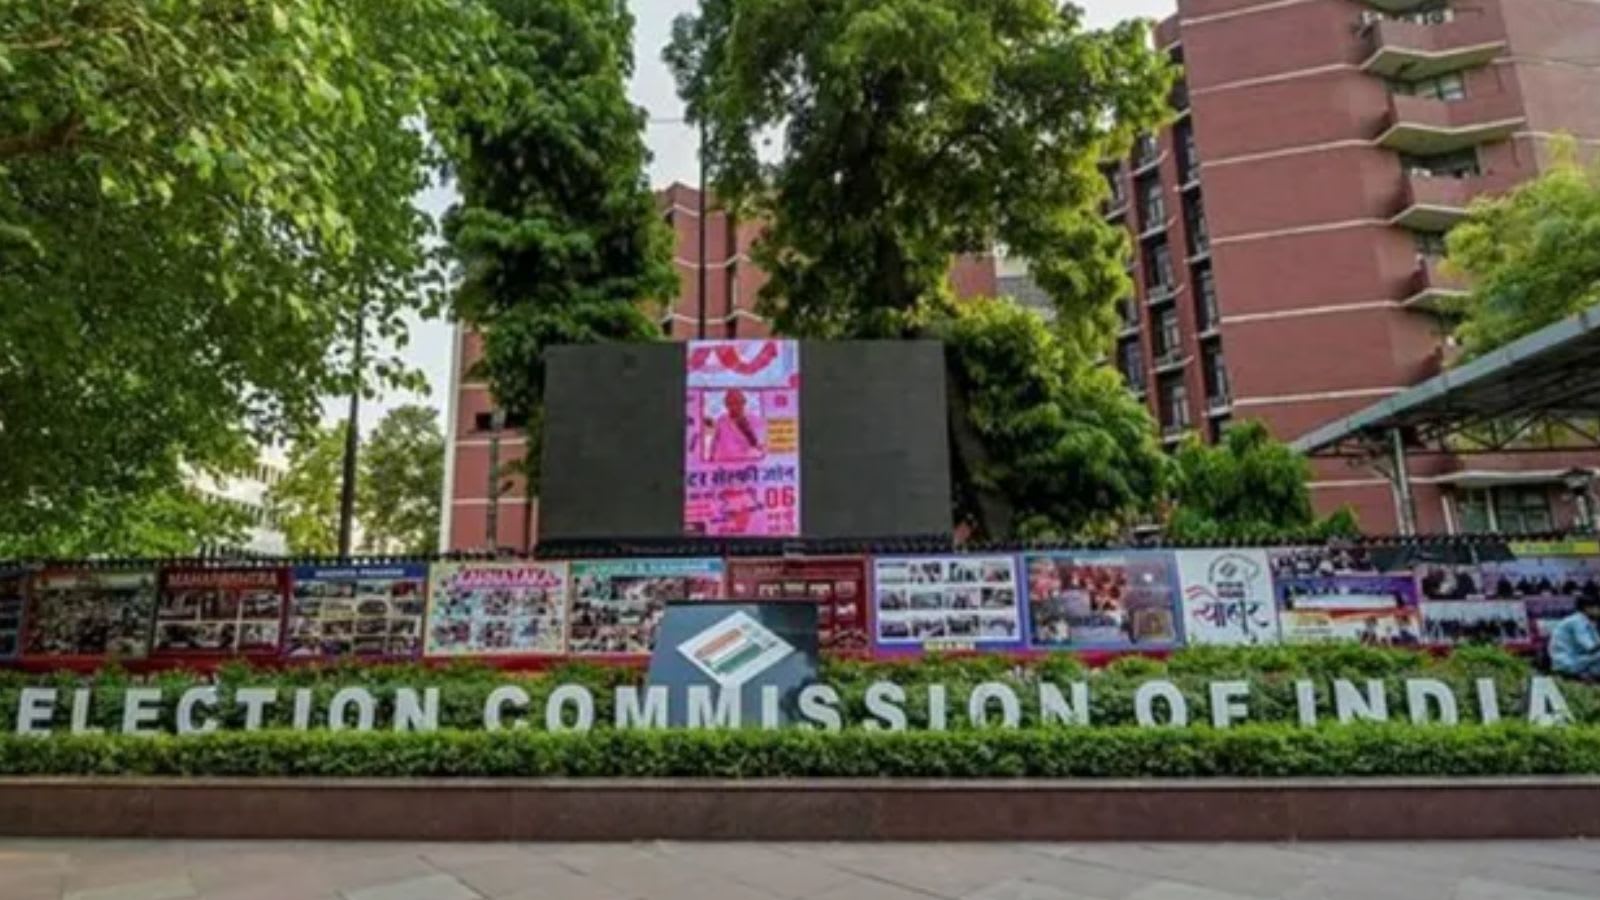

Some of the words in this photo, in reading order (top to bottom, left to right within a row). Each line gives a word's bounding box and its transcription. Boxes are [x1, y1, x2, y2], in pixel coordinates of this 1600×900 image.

[766, 486, 796, 509] 06
[17, 686, 439, 735] ELECTION
[484, 682, 1090, 730] COMMISSION
[1135, 679, 1250, 728] OF
[1296, 678, 1573, 725] INDIA
